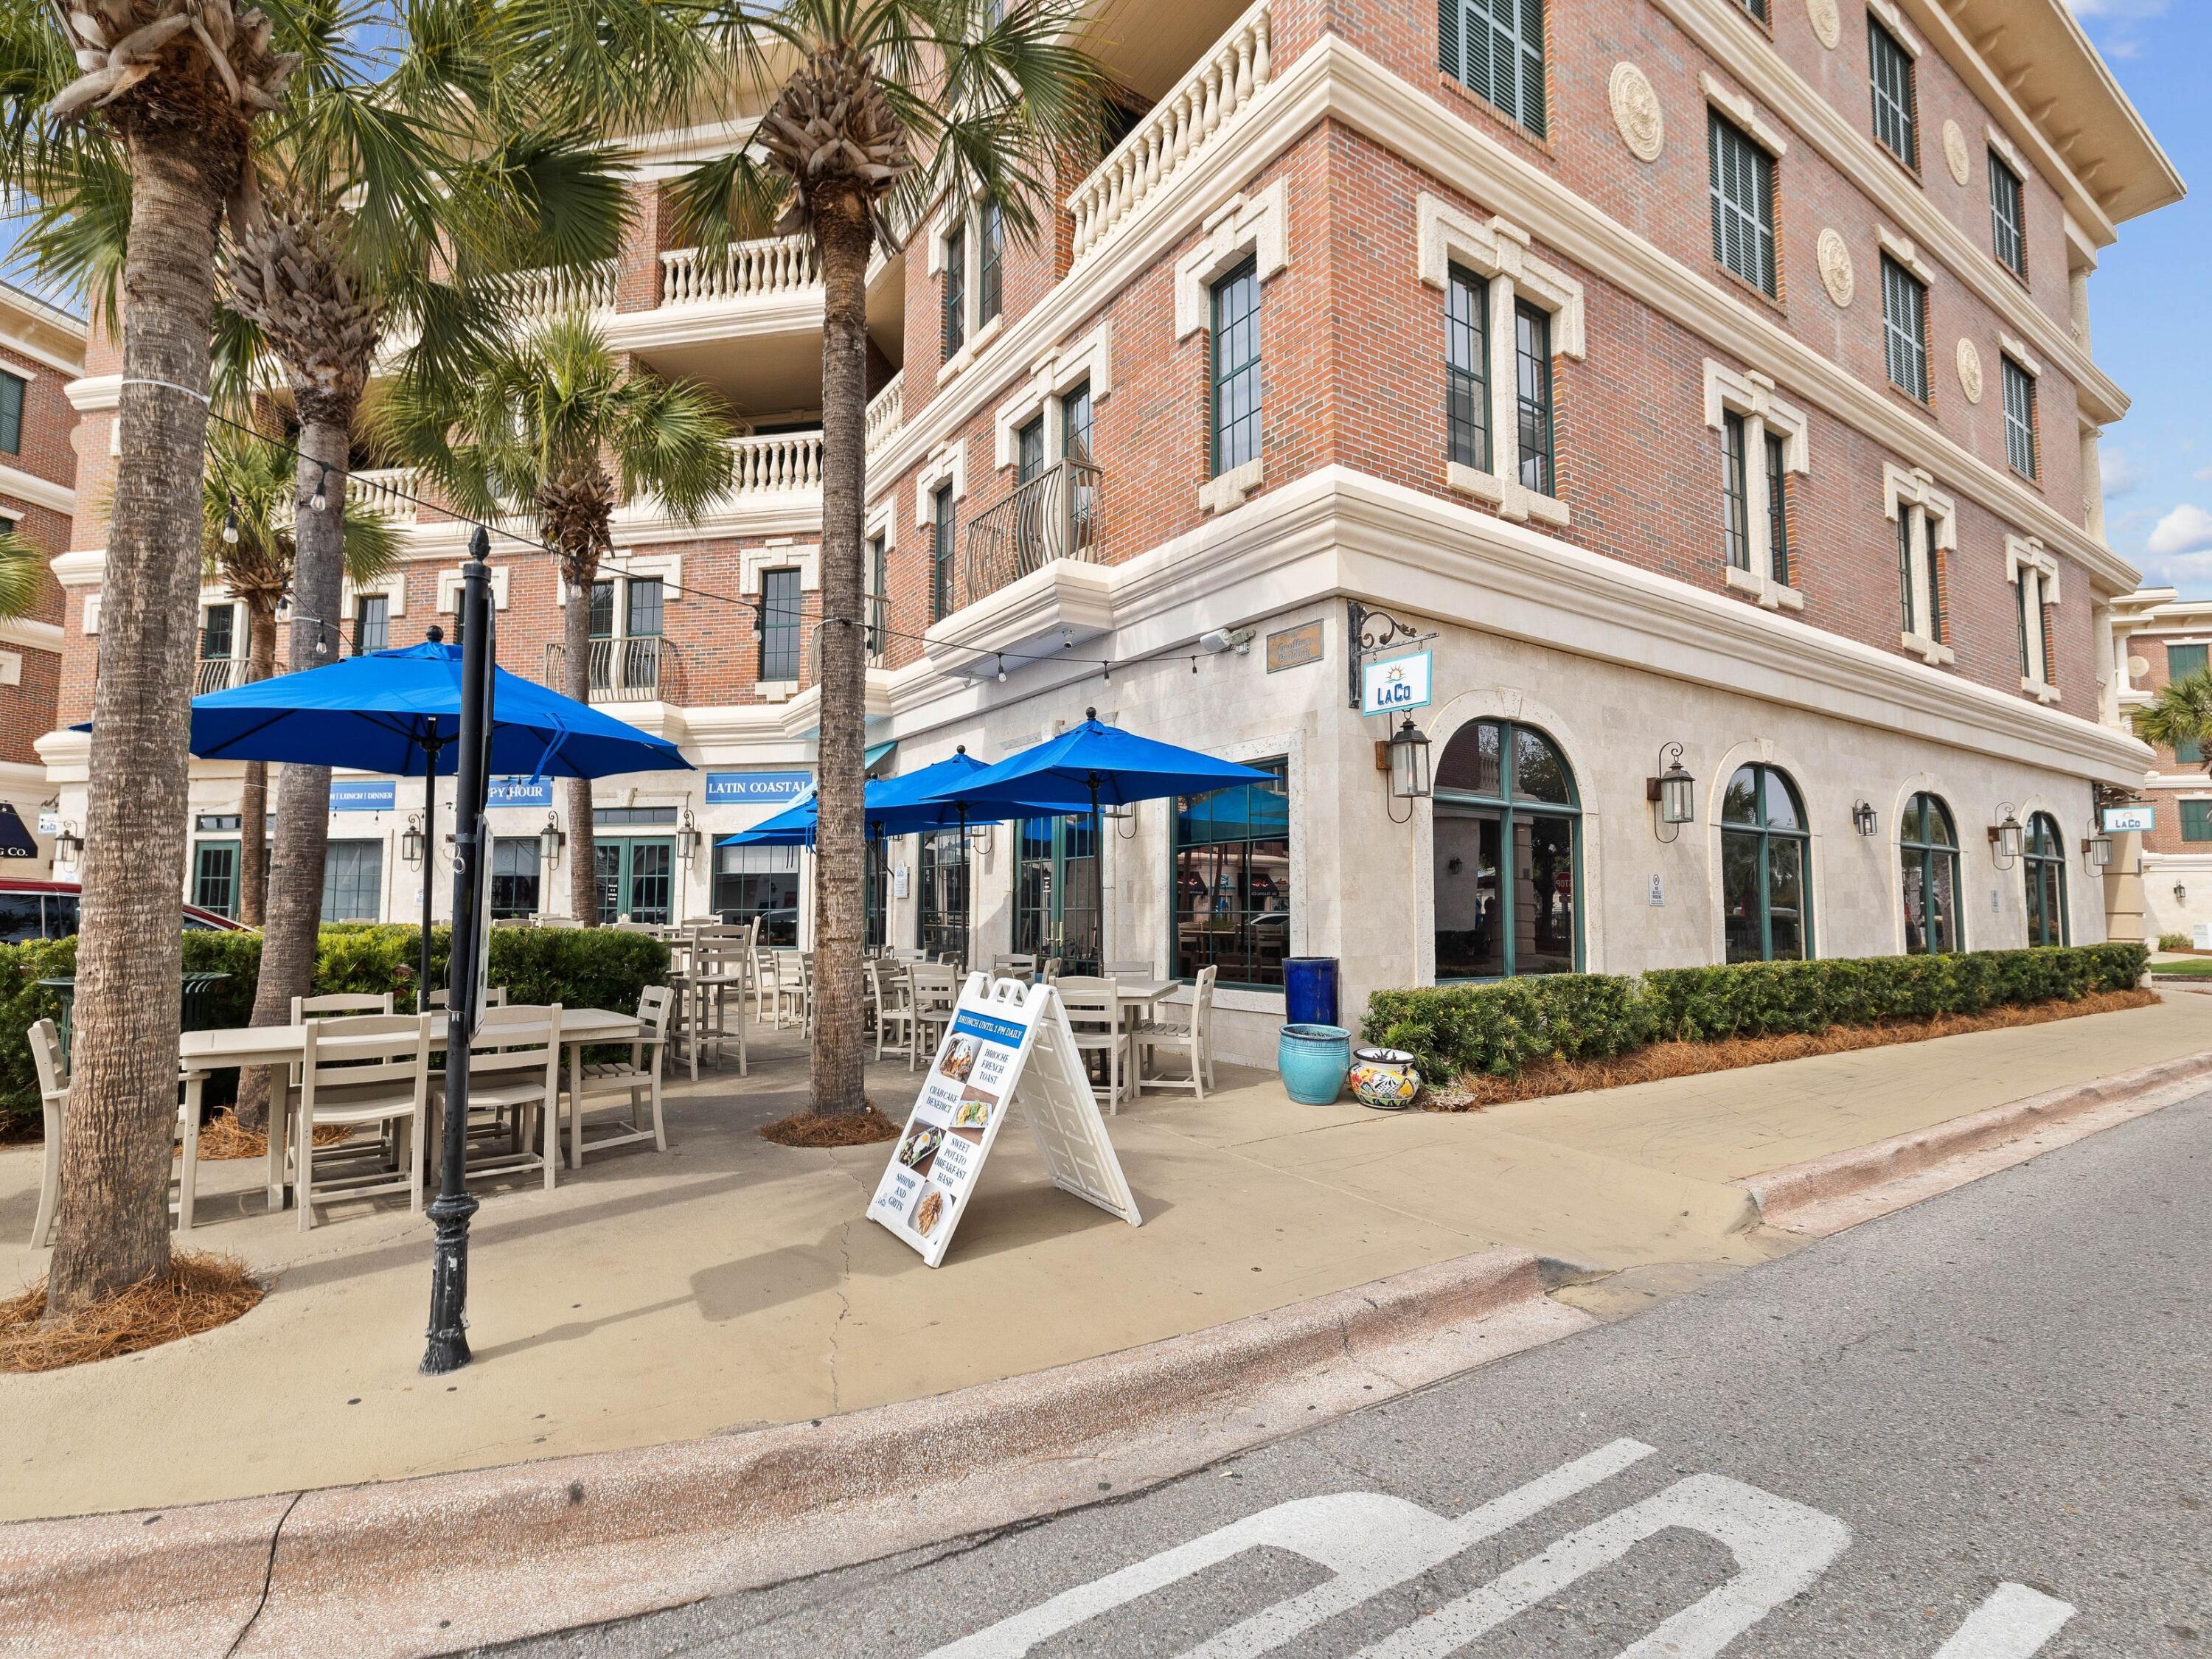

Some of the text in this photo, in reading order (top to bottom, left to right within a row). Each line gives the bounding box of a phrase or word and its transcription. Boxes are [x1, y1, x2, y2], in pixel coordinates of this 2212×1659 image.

[509, 786, 543, 797] HOUR
[708, 782, 745, 793] LATIN
[340, 792, 363, 801] LUNCH
[367, 791, 393, 800] DINNER
[958, 1015, 1023, 1039] BRUNCH UNTIL 1 PM DAILY
[984, 1048, 1009, 1063] BRIOCHE
[981, 1060, 1005, 1074] FRENCH
[978, 1071, 998, 1085] TOAST
[926, 1096, 953, 1113] BENEDICT
[950, 1138, 970, 1153] SWEET
[944, 1147, 967, 1166] POTATO
[934, 1156, 967, 1180] BREAKFAST
[895, 1172, 916, 1189] SHRIMP
[936, 1172, 954, 1187] HASH
[894, 1186, 907, 1199] AND
[888, 1196, 904, 1211] GRITS
